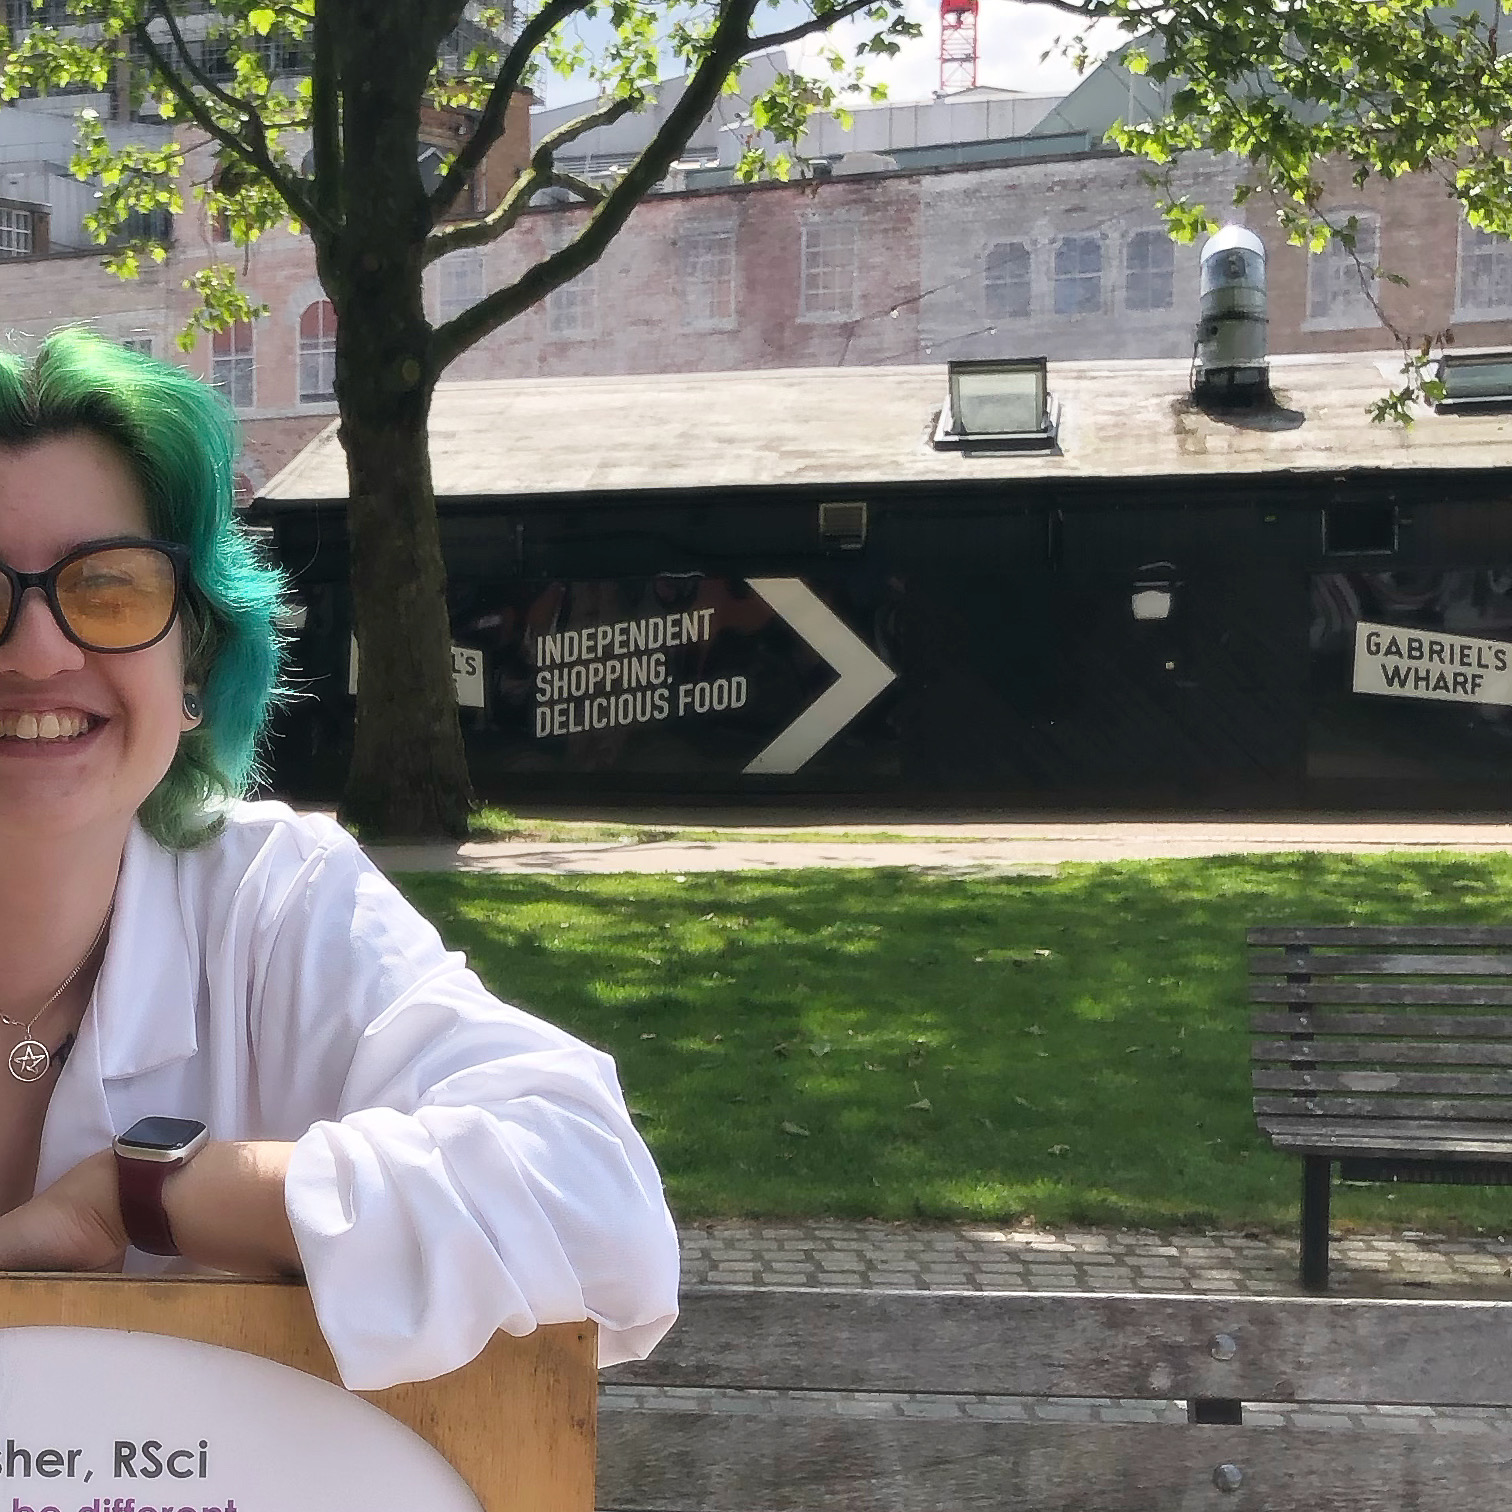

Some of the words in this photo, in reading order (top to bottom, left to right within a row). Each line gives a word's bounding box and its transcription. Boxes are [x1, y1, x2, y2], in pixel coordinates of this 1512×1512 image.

[536, 607, 716, 668] INDEPENDENT
[1366, 631, 1507, 671] GABRIEL'S
[1380, 662, 1484, 696] WHARF
[535, 687, 670, 738] DELICIOUS
[678, 675, 747, 717] FOOD
[113, 1438, 208, 1478] RSci
